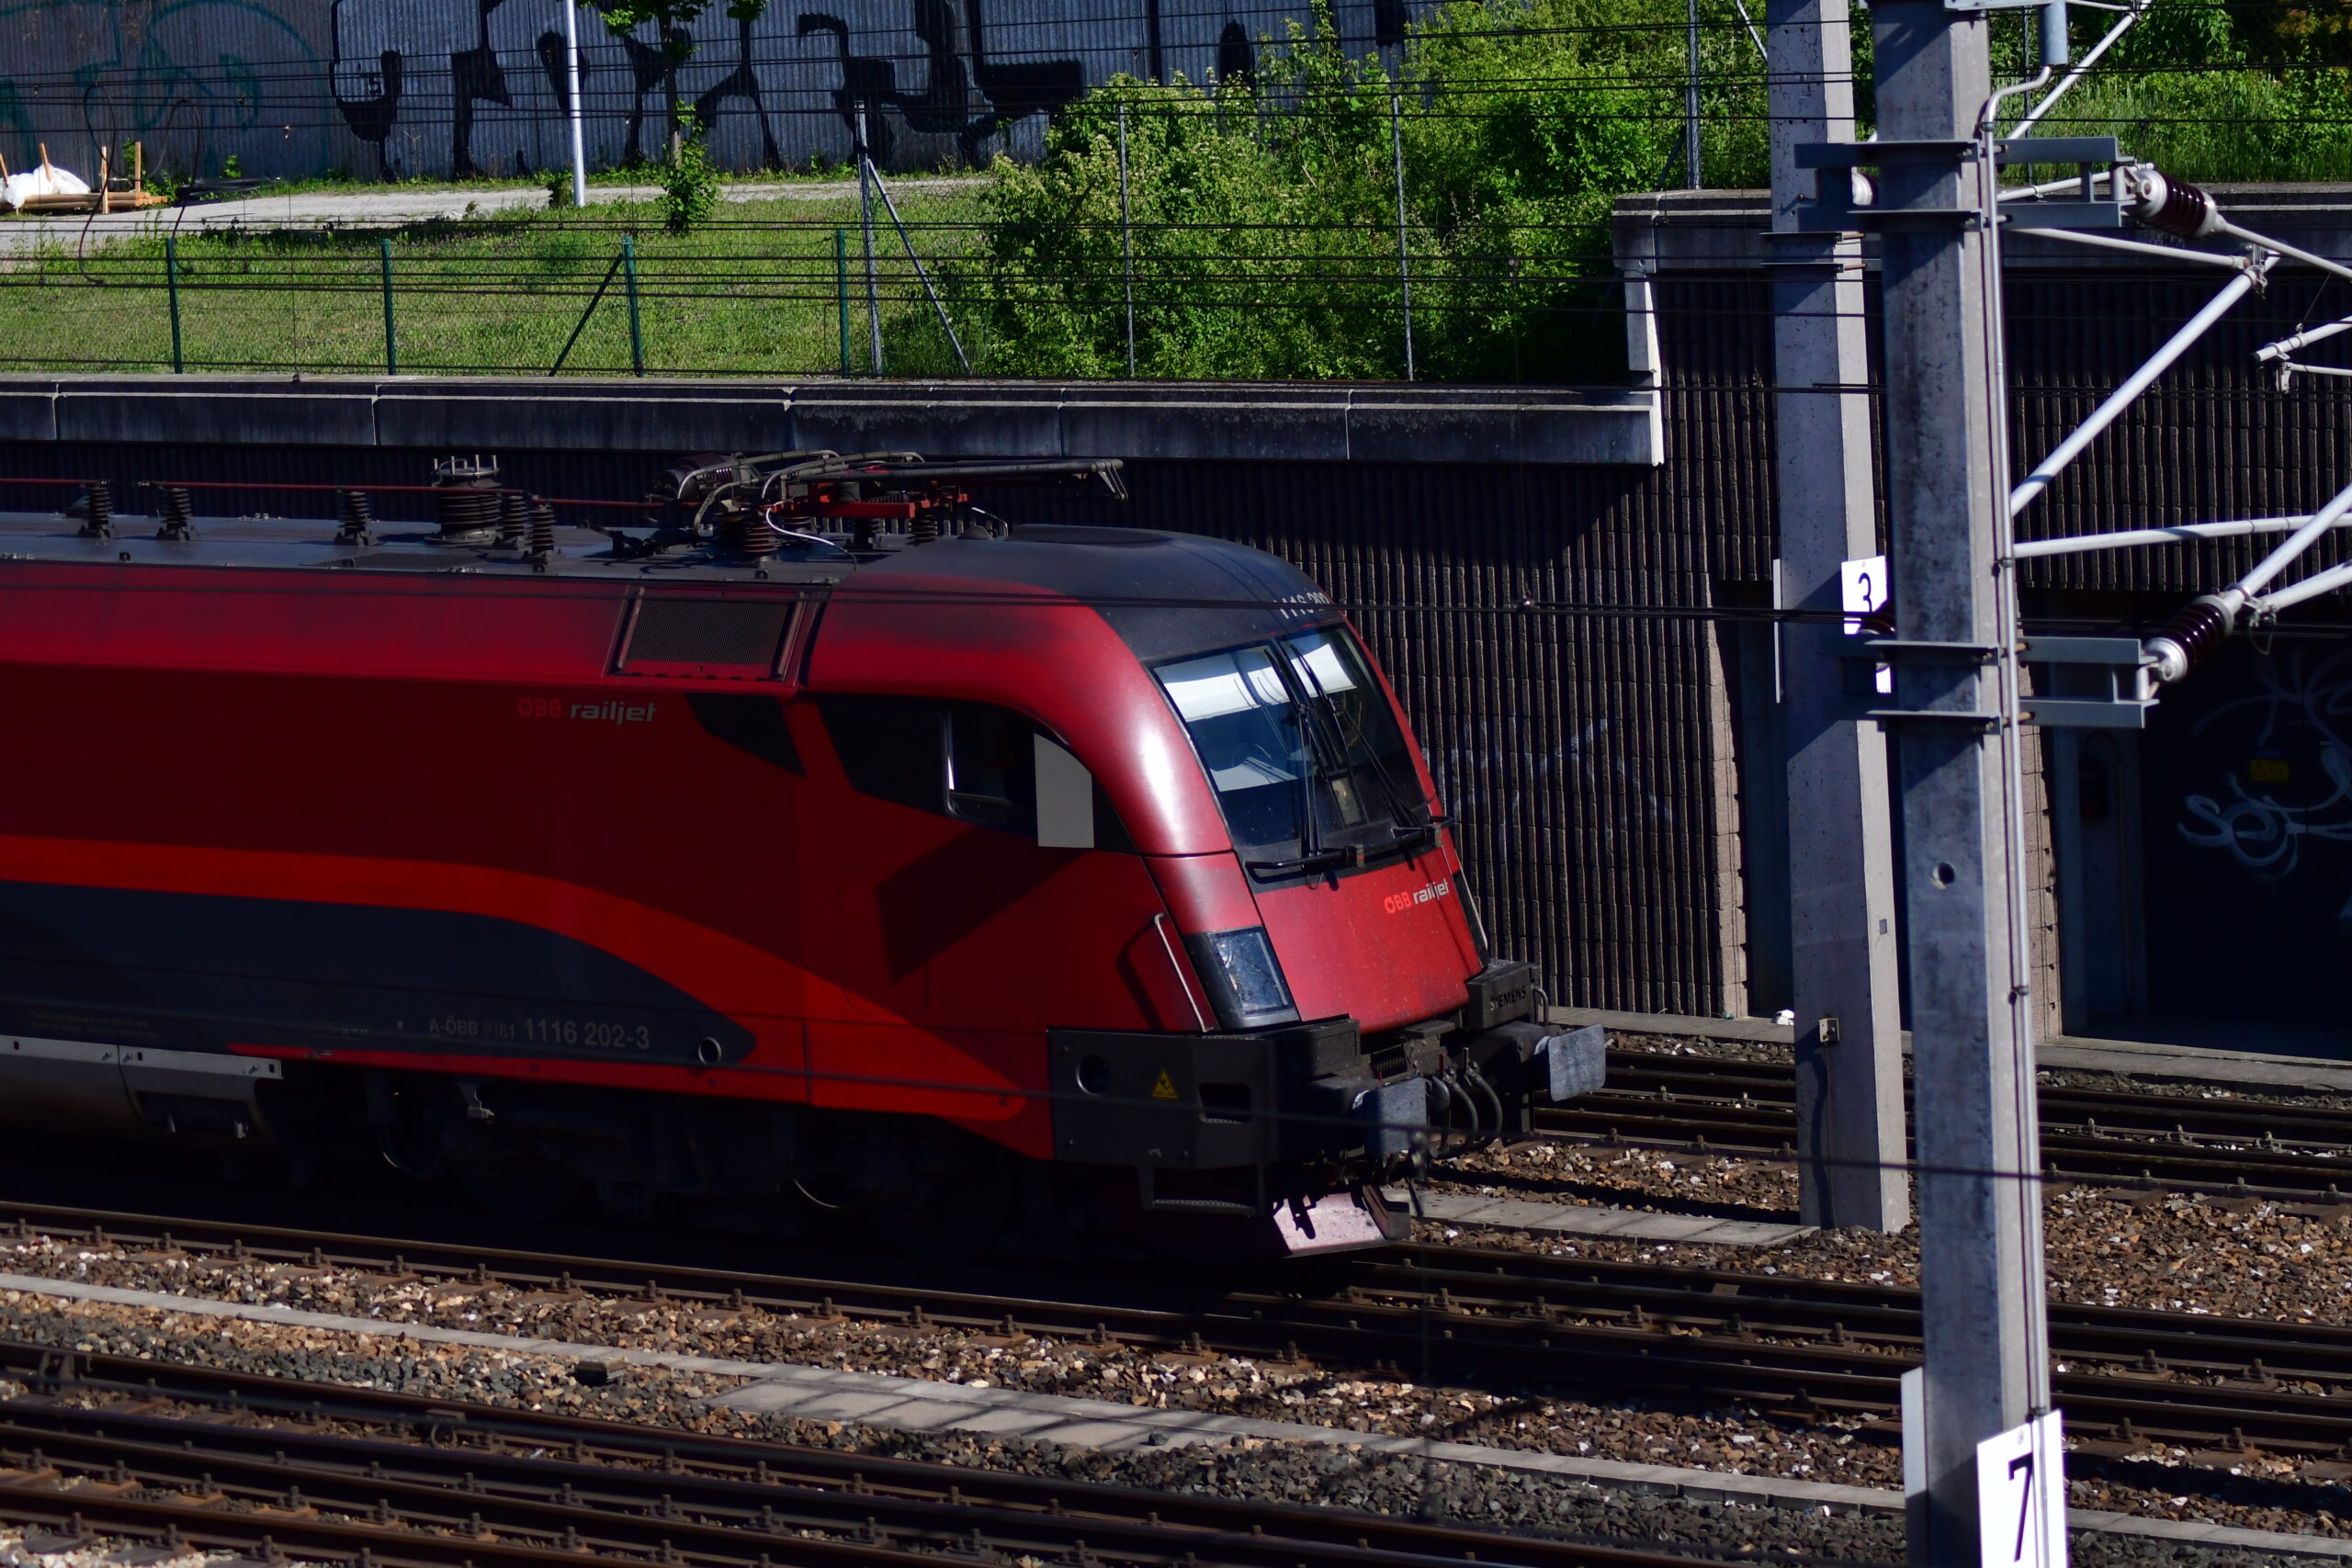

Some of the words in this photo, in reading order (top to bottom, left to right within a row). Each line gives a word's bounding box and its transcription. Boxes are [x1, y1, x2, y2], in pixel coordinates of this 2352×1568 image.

[1858, 572, 1872, 614] 3
[516, 695, 562, 718] ÖBB
[569, 700, 657, 726] railjet
[1412, 877, 1450, 905] railjet
[1488, 985, 1527, 1011] SIEMENS
[523, 1016, 578, 1044] 1116
[583, 1021, 650, 1050] 202-3
[2008, 1451, 2034, 1562] 7
